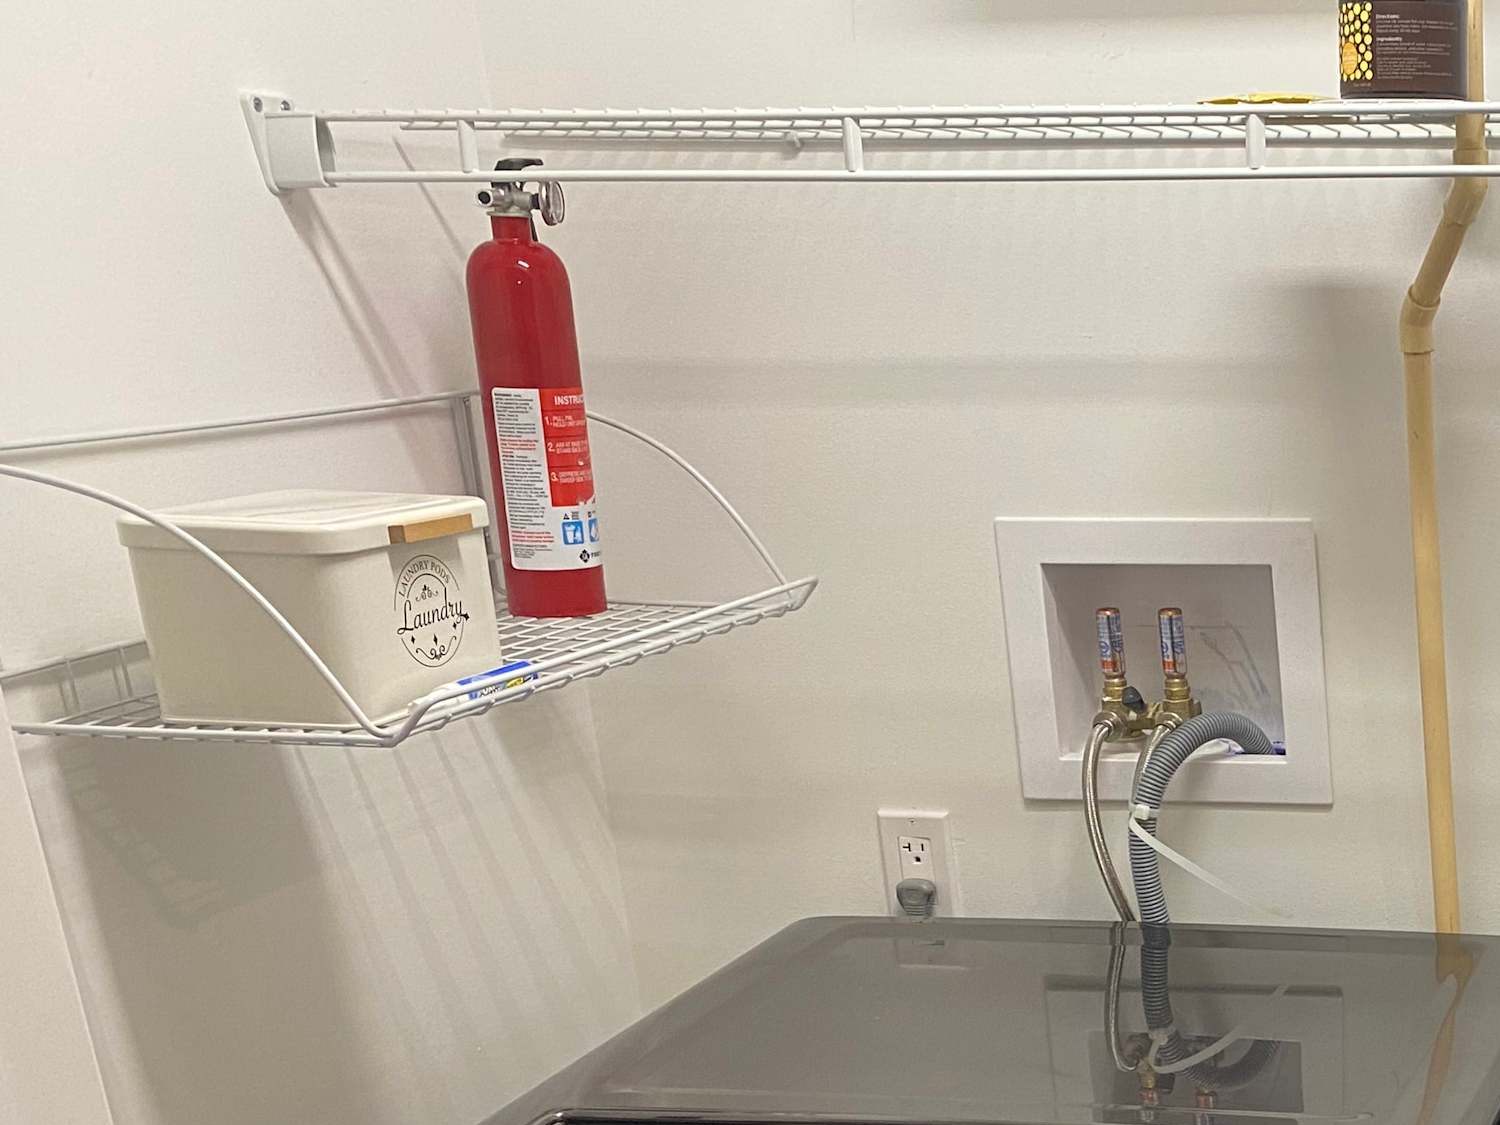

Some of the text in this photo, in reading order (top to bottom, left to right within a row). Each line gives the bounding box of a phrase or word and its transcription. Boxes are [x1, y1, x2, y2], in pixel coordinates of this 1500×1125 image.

[398, 559, 450, 597] LAUNDRY PODS
[397, 599, 466, 635] Laundry
